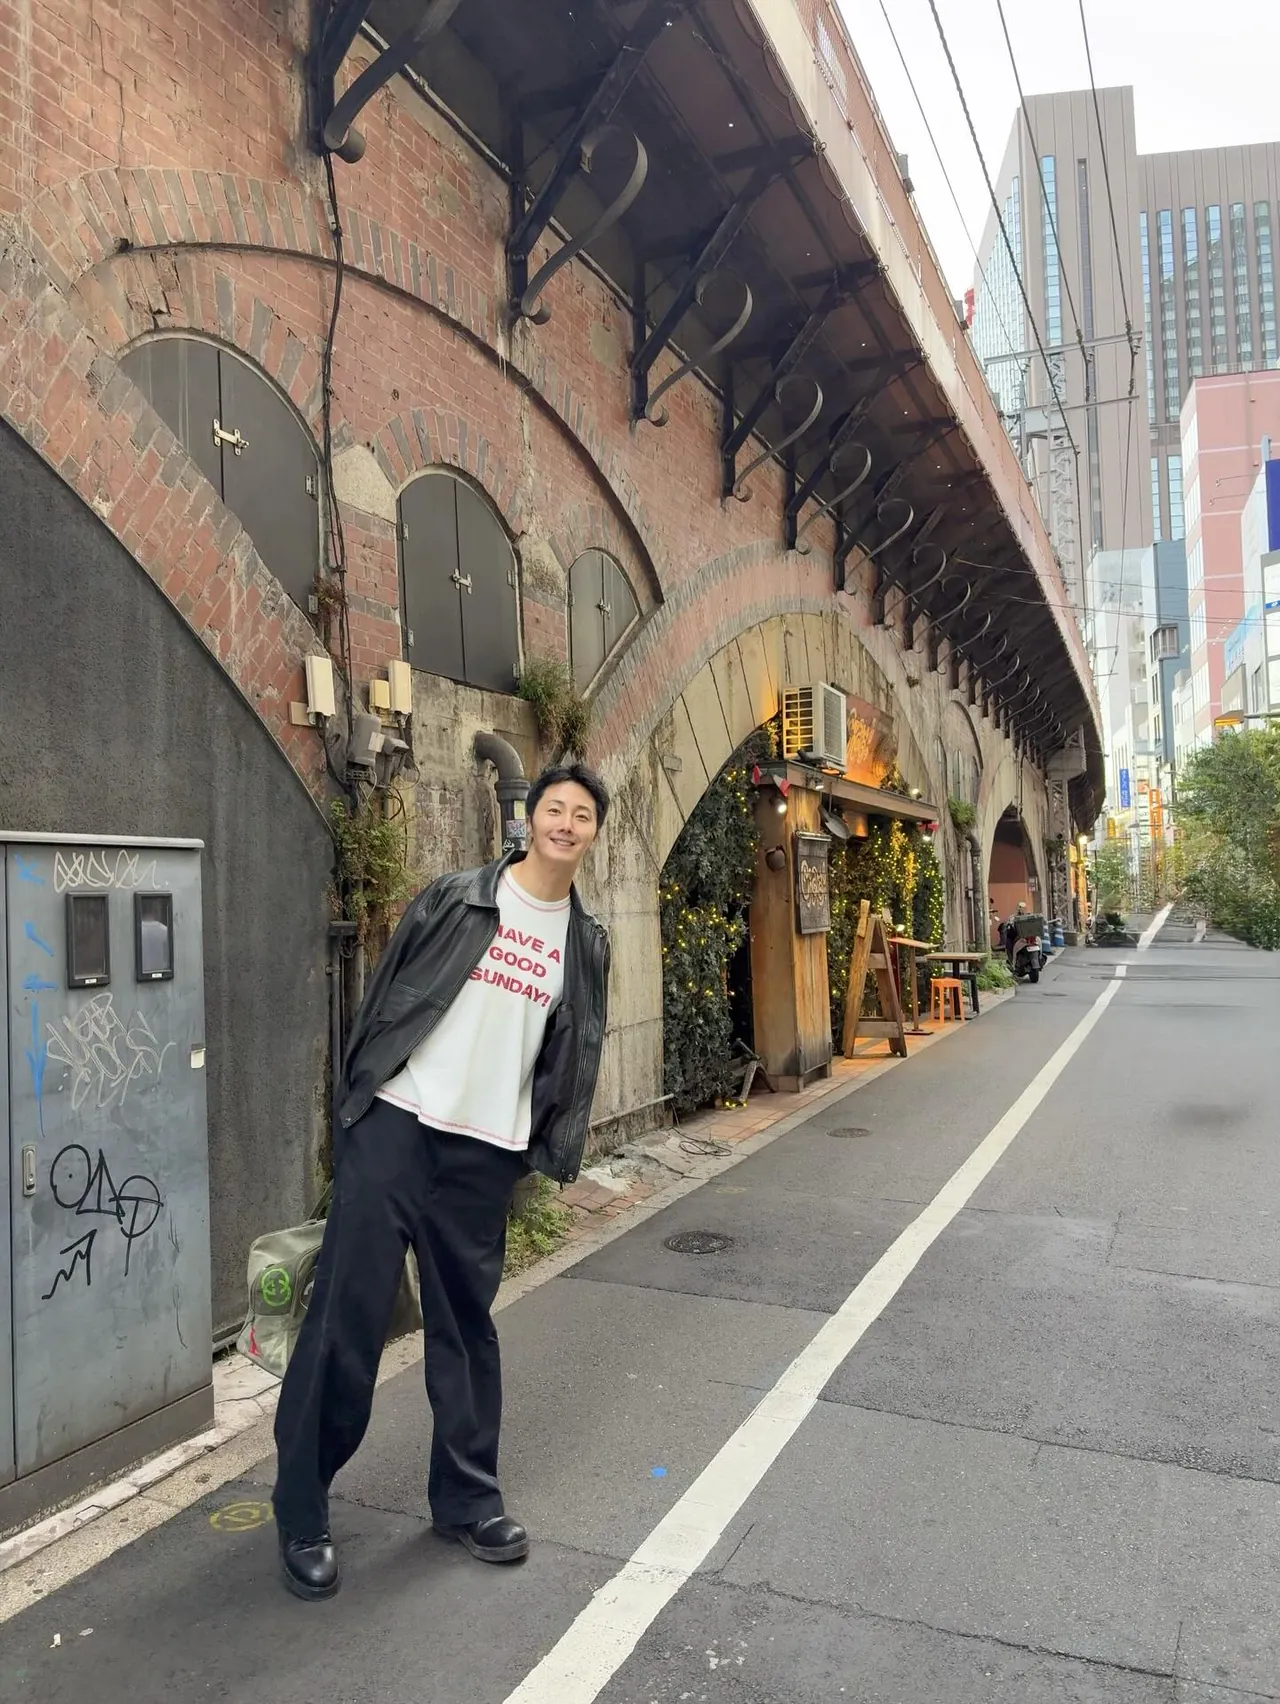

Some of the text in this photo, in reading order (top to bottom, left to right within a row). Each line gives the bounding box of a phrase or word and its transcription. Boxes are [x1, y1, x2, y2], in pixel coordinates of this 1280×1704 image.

[489, 946, 547, 978] GOOD
[547, 948, 561, 964] A
[468, 966, 551, 1008] SUNDAY!
